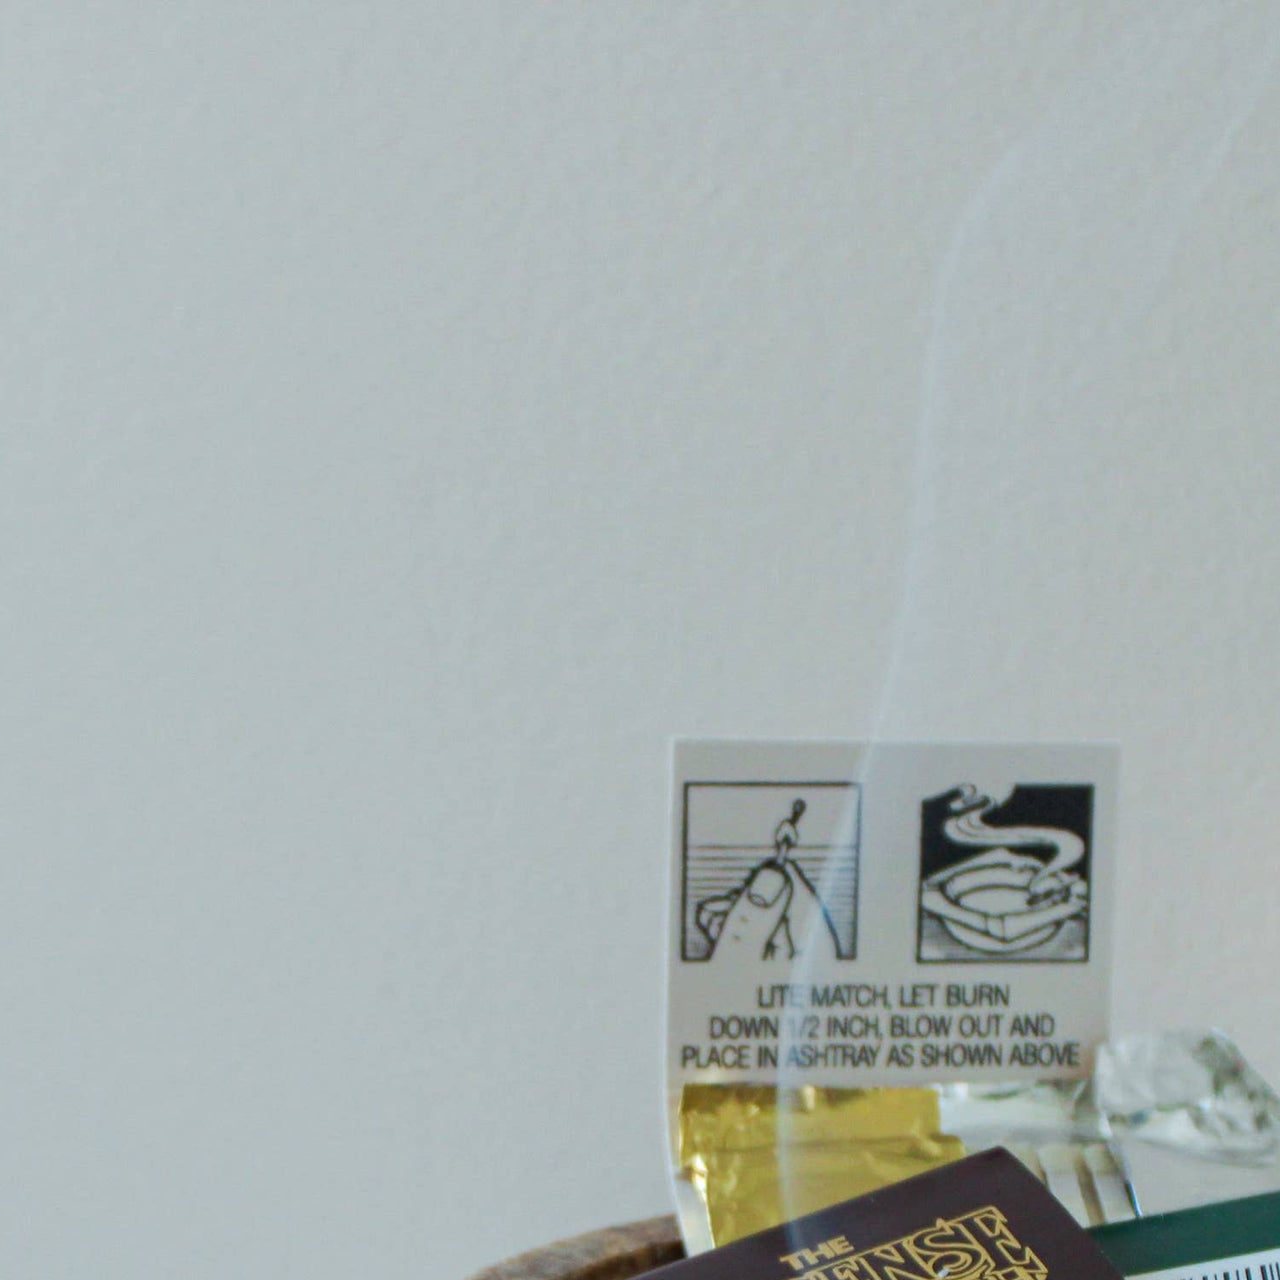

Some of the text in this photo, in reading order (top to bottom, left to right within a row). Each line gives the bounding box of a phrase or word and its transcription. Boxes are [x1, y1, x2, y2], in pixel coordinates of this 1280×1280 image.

[757, 983, 1010, 1010] LITE MATCH, LET BURN
[709, 1015, 779, 1040] DOWN
[827, 1015, 883, 1040] INCH,
[890, 1014, 951, 1038] BLOW
[958, 1014, 1003, 1038] OUT
[1010, 1013, 1056, 1037] AND
[681, 1041, 1080, 1069] PLACE IN ASHTRAY AS SHOWN ABOVE
[779, 1235, 854, 1271] THE
